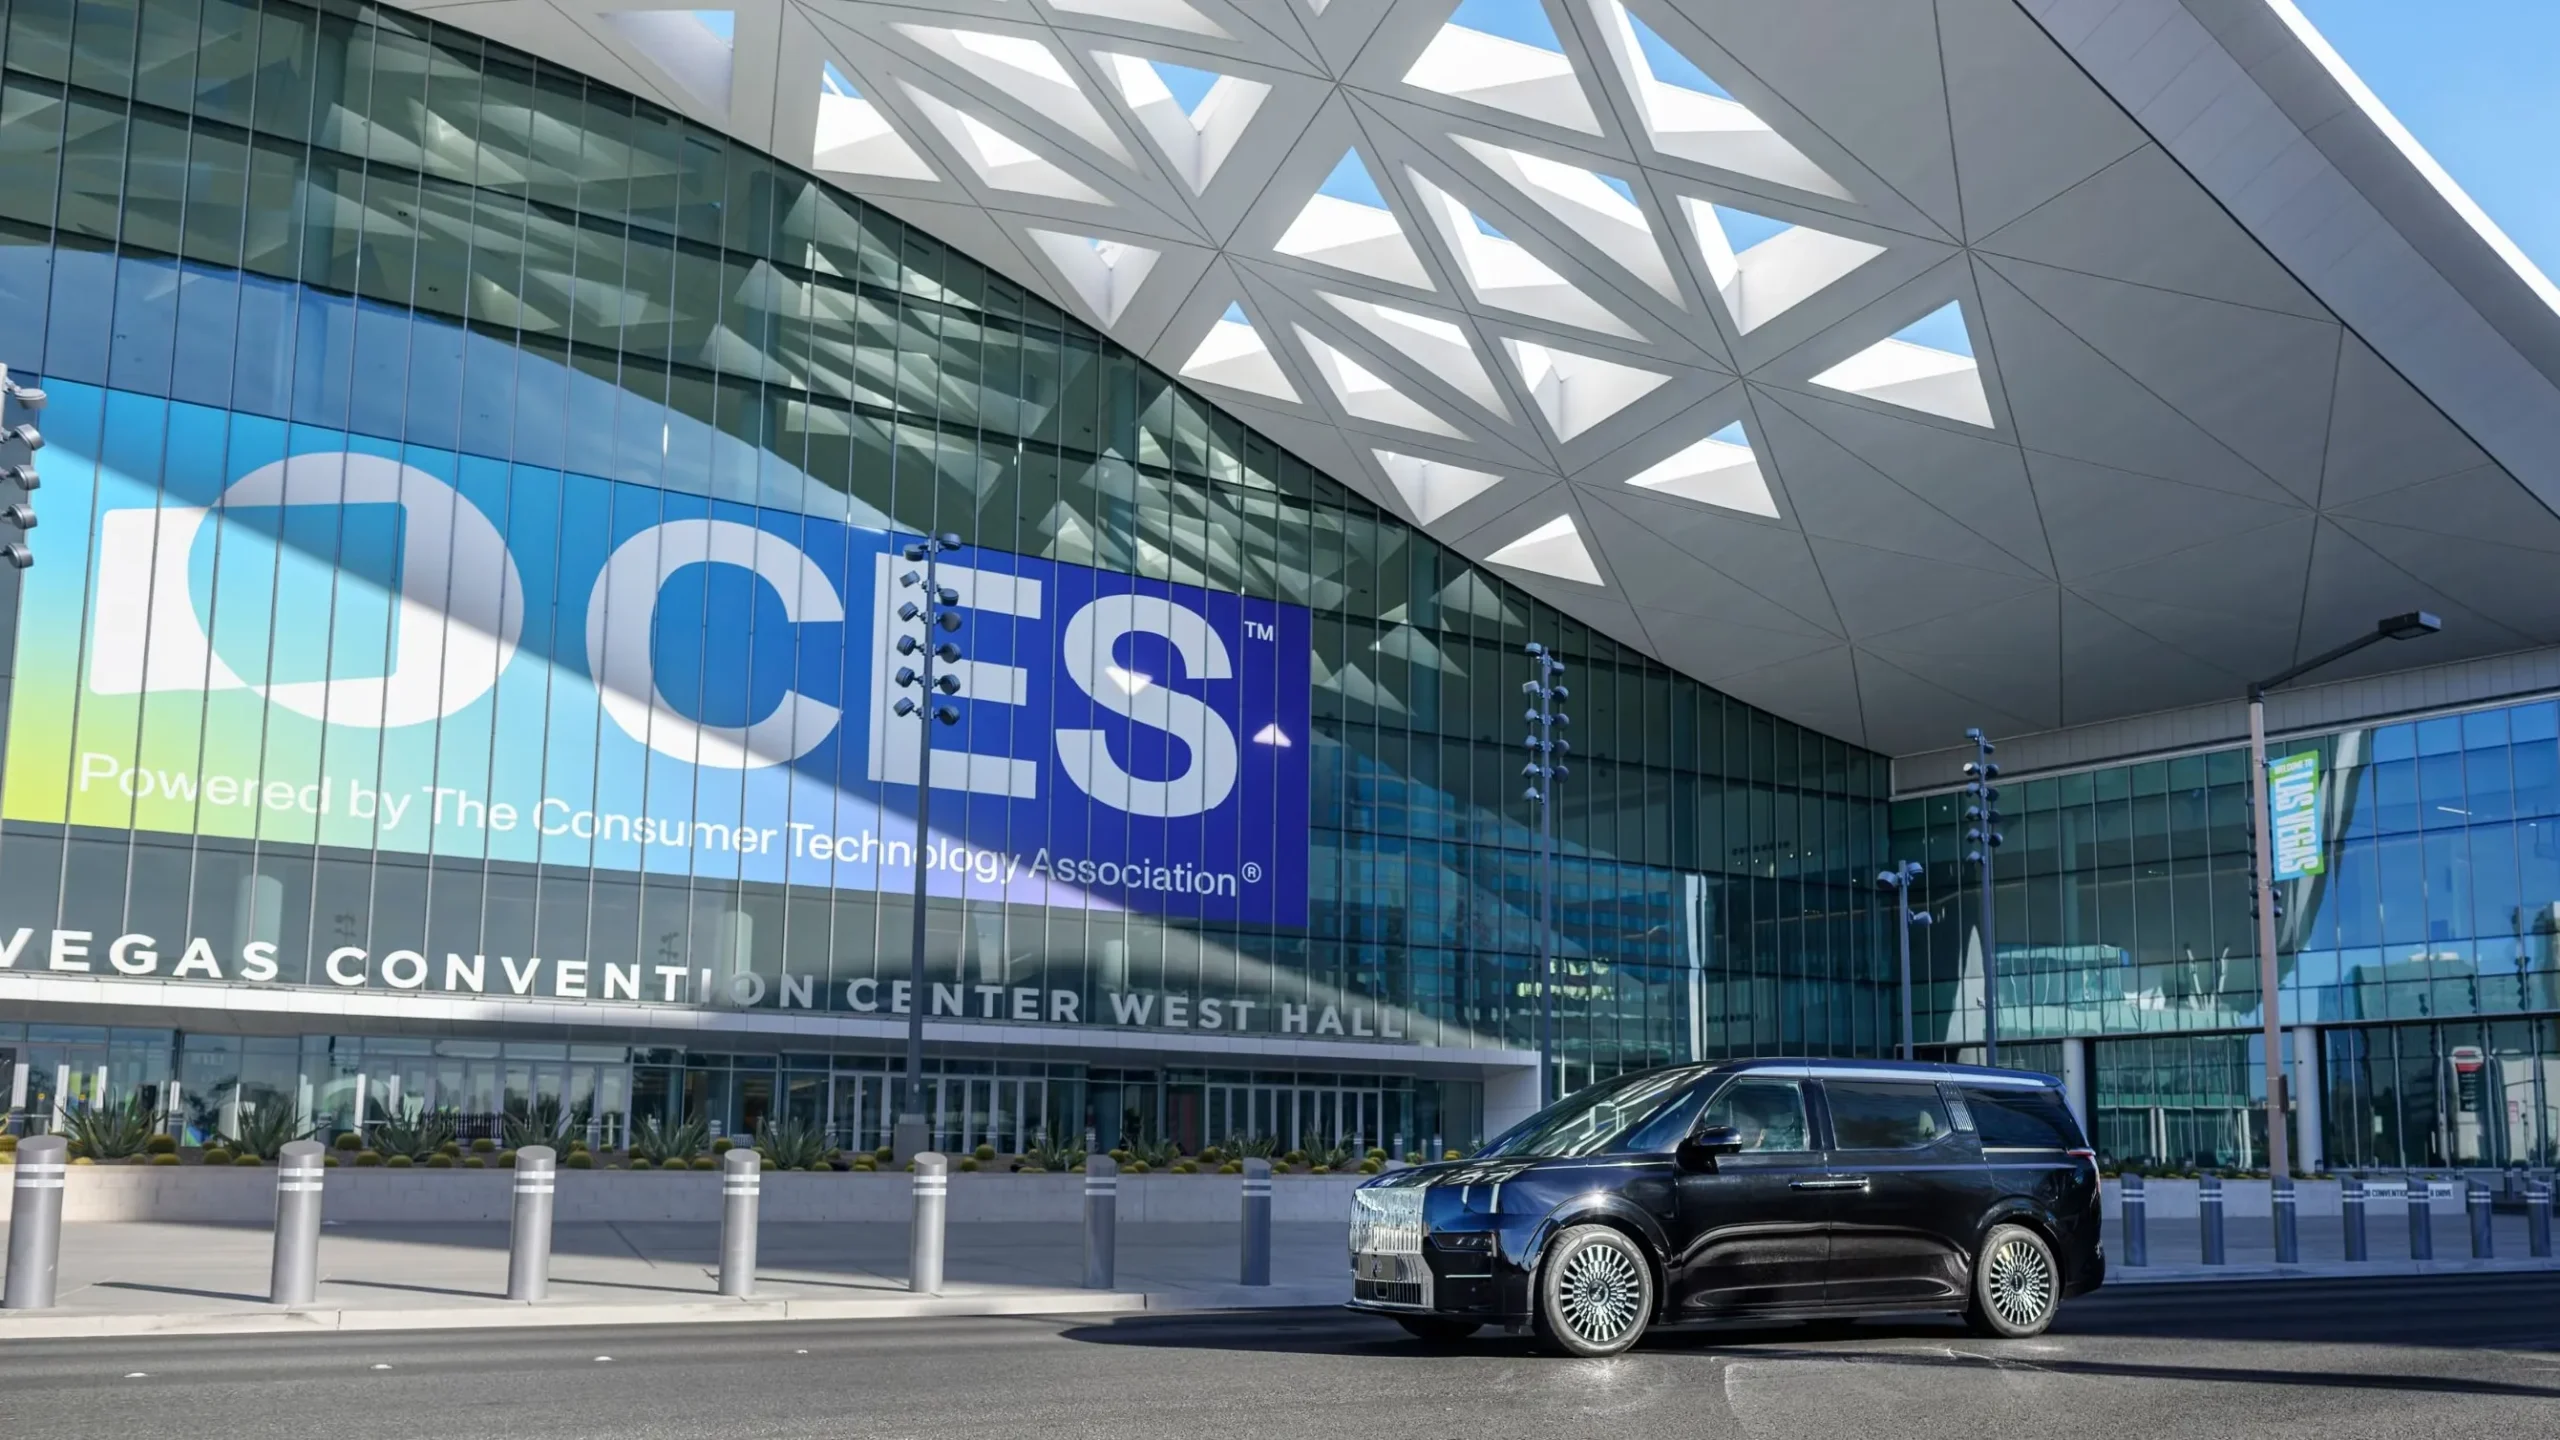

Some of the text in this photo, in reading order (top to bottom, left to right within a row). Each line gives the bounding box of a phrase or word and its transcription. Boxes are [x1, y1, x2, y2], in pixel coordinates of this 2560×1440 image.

[79, 752, 332, 815] Powered
[350, 779, 412, 830] by
[423, 786, 518, 832] The
[533, 798, 777, 855] Consumer
[785, 822, 1021, 885] Technology
[2275, 771, 2319, 874] LAS VEGAS
[325, 946, 814, 1009] CONVENTION
[846, 977, 1080, 1022] CENTER
[1109, 992, 1256, 1032] WEST
[1283, 1003, 1403, 1038] HALL
